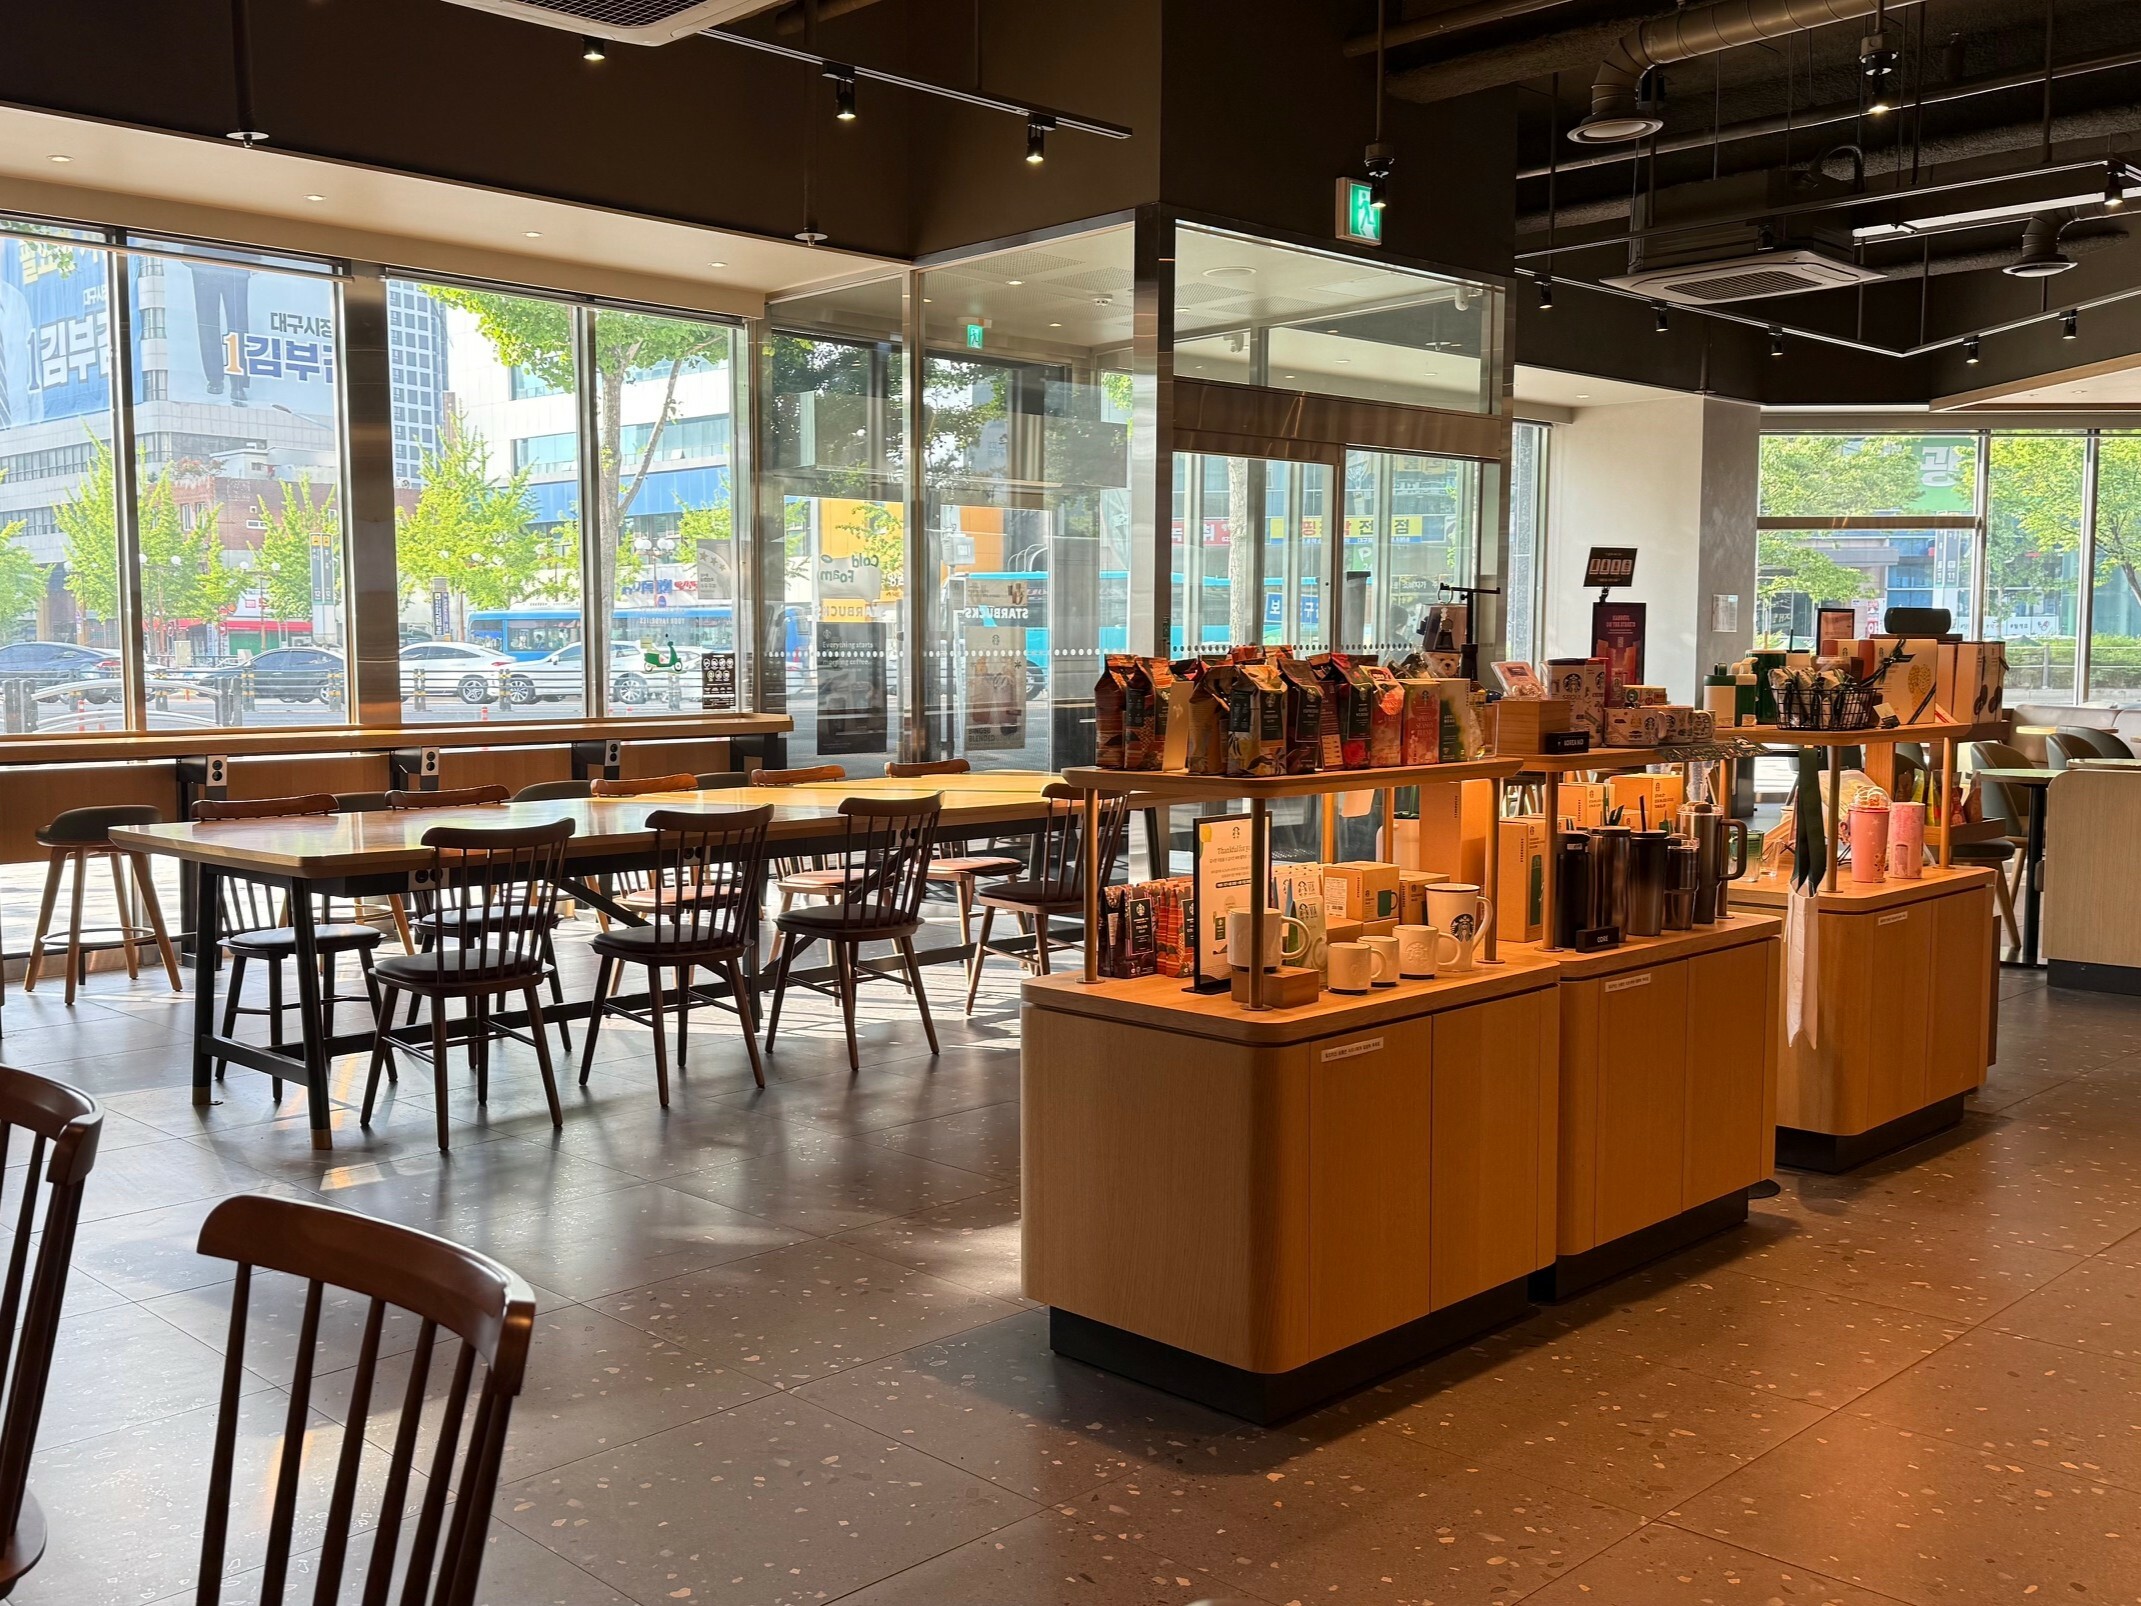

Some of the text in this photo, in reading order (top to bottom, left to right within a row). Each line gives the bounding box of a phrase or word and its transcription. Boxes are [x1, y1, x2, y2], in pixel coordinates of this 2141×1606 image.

[245, 333, 334, 384] 김부
[822, 641, 874, 649] Everything starts
